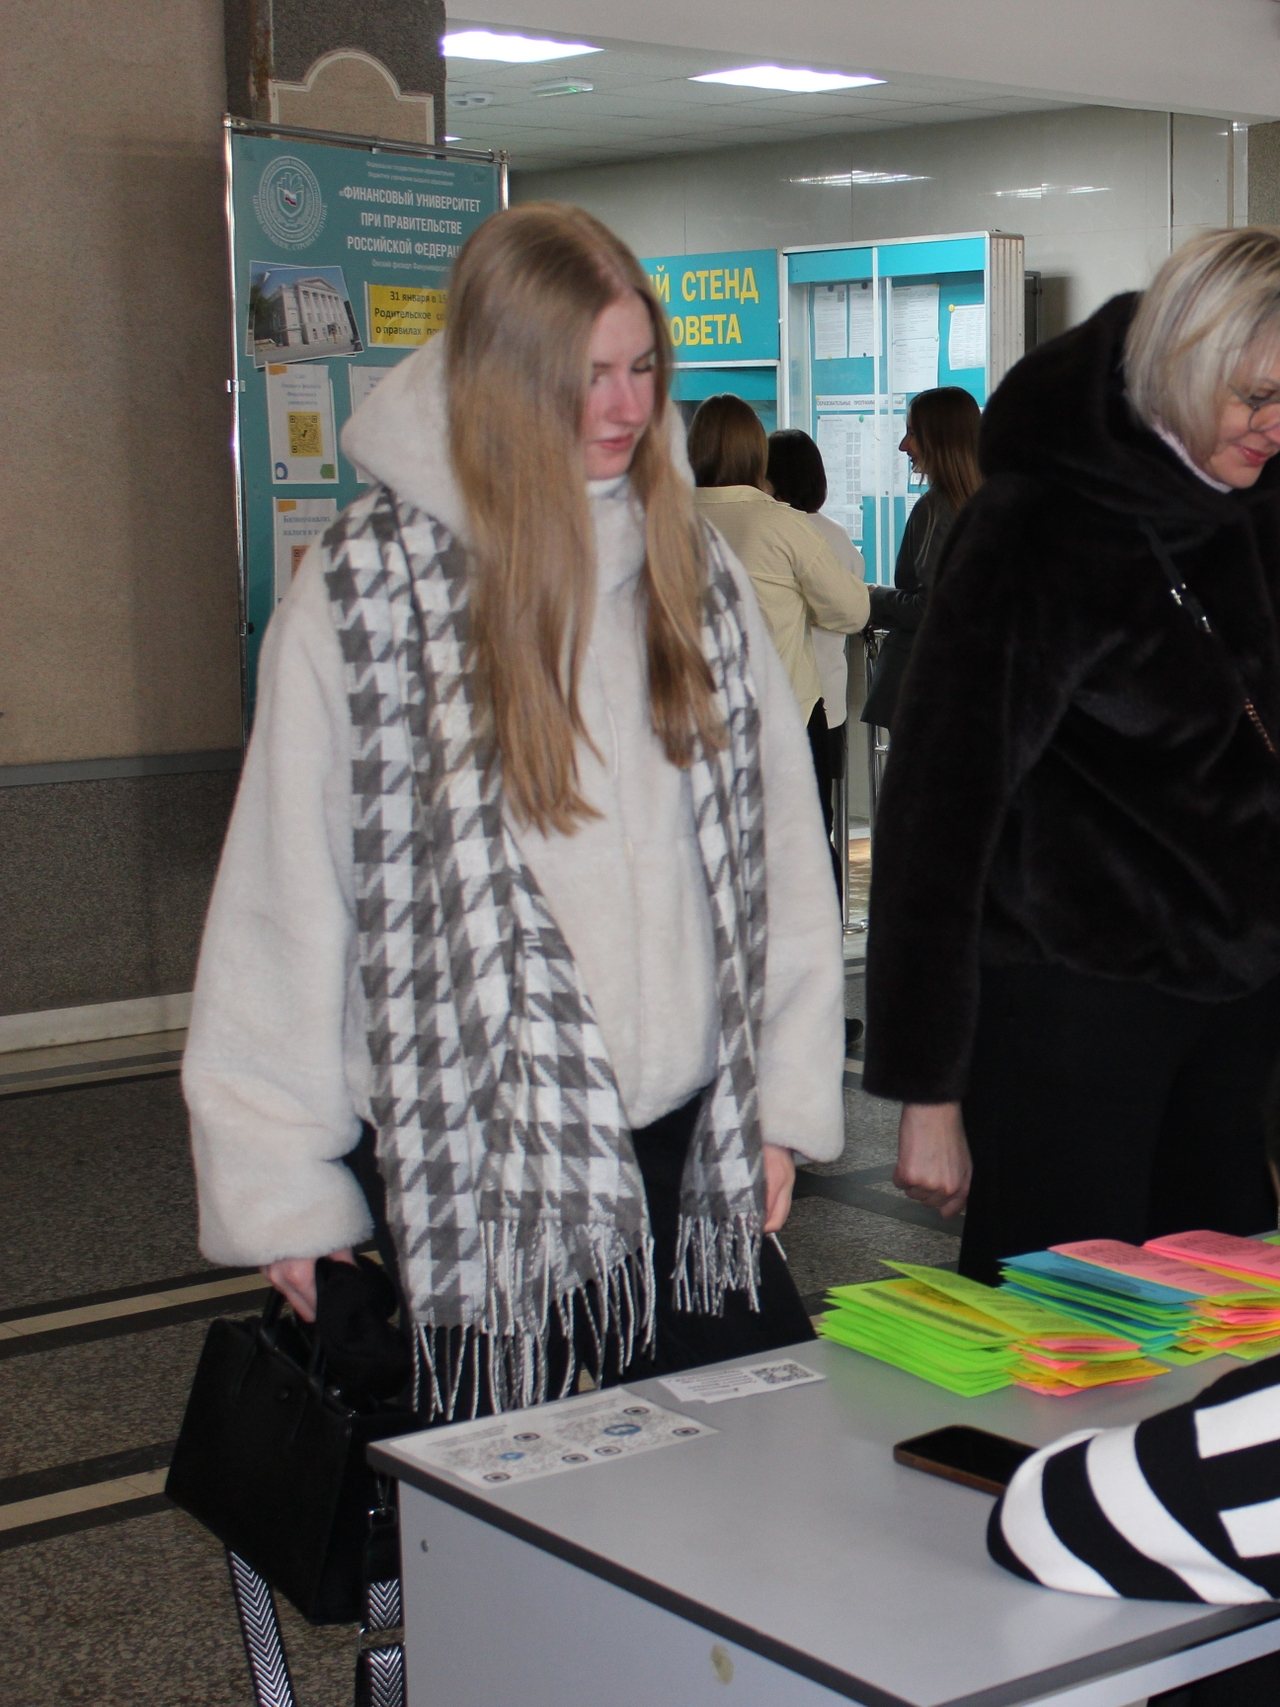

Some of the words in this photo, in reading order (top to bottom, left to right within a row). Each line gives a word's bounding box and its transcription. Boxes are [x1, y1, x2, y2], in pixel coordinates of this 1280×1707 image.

[339, 186, 413, 206] «ФИНАНСОВЫЙ
[416, 193, 481, 213] УНИВЕРСИТЕТ
[361, 212, 381, 227] ПРИ
[384, 215, 462, 235] ПРАВИТЕЛЬСТВЕ
[347, 236, 413, 254] РОССИЙСКОЙ
[415, 242, 461, 259] ФЕДЕРАЦ
[681, 267, 759, 304] СТЕНД
[390, 291, 400, 301] 31
[402, 294, 430, 304] января
[374, 307, 431, 320] Родительское
[384, 327, 421, 336] правилах
[670, 313, 742, 347] ОВЕТА
